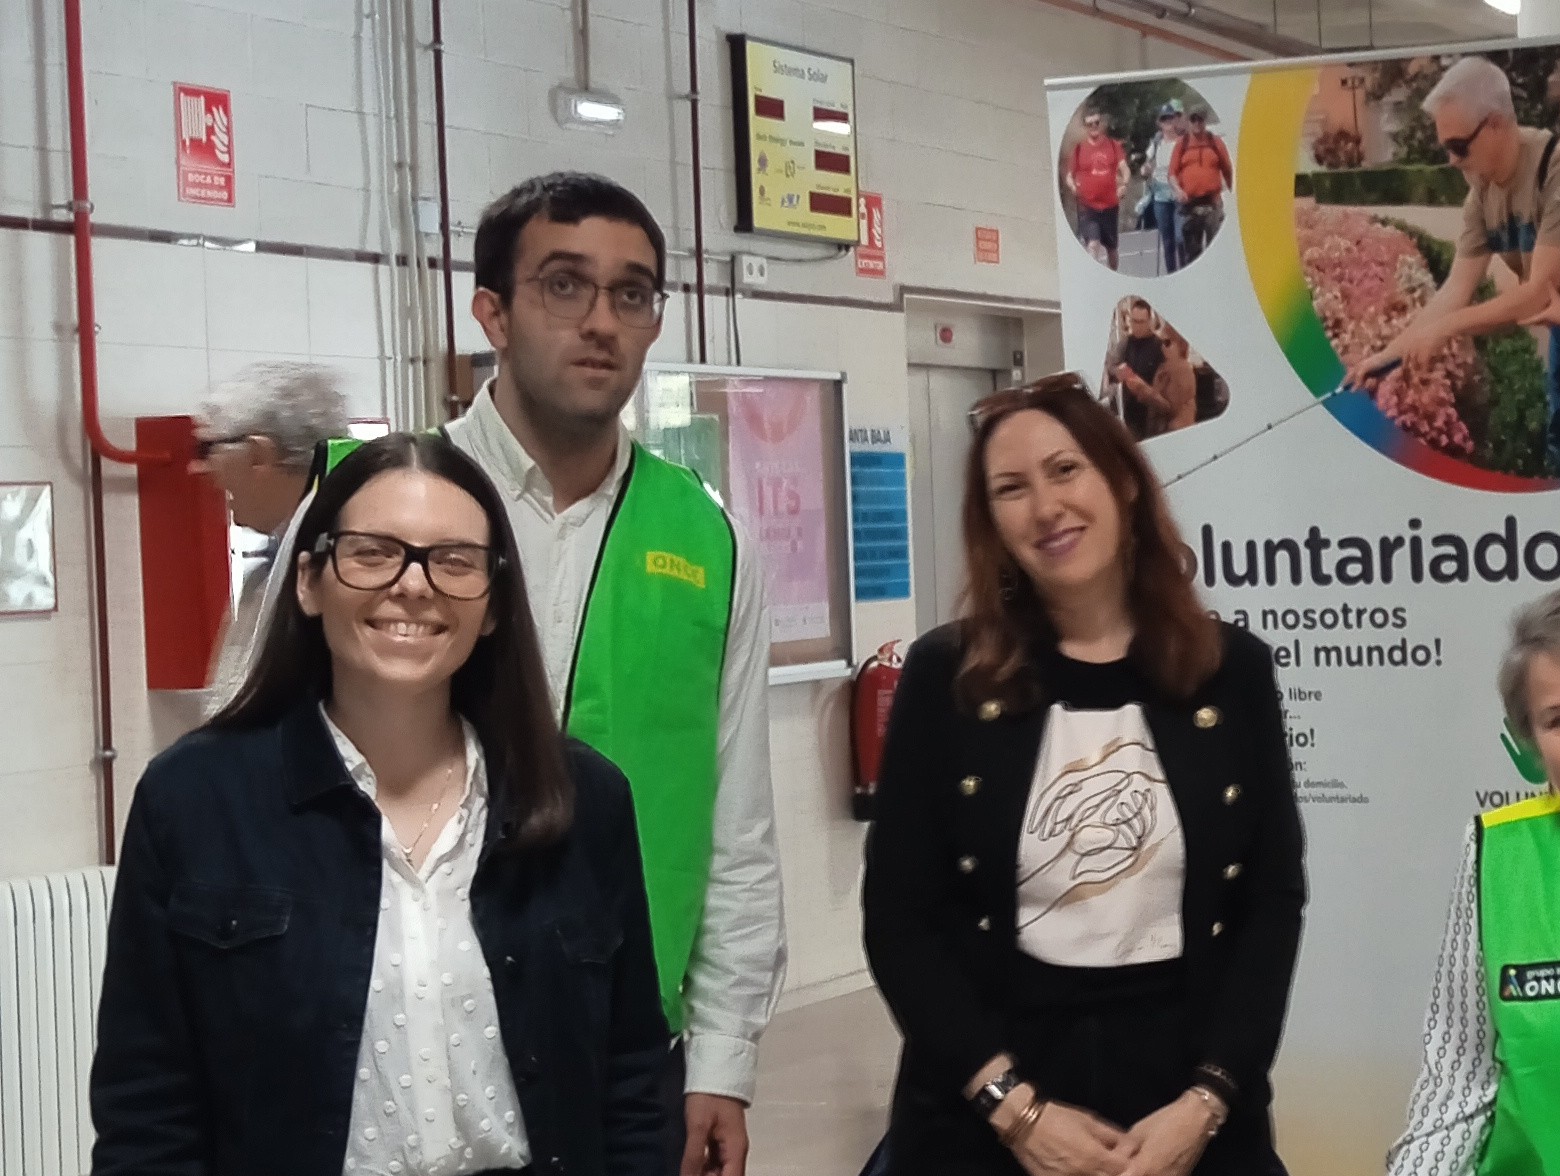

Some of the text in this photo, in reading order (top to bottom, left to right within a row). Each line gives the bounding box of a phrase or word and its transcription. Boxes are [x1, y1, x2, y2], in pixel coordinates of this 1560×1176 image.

[849, 428, 869, 443] ANTA
[1261, 602, 1407, 631] nosotros
[1274, 637, 1443, 668] el mundo!
[1289, 687, 1323, 702] libre
[1526, 968, 1555, 979] grupo
